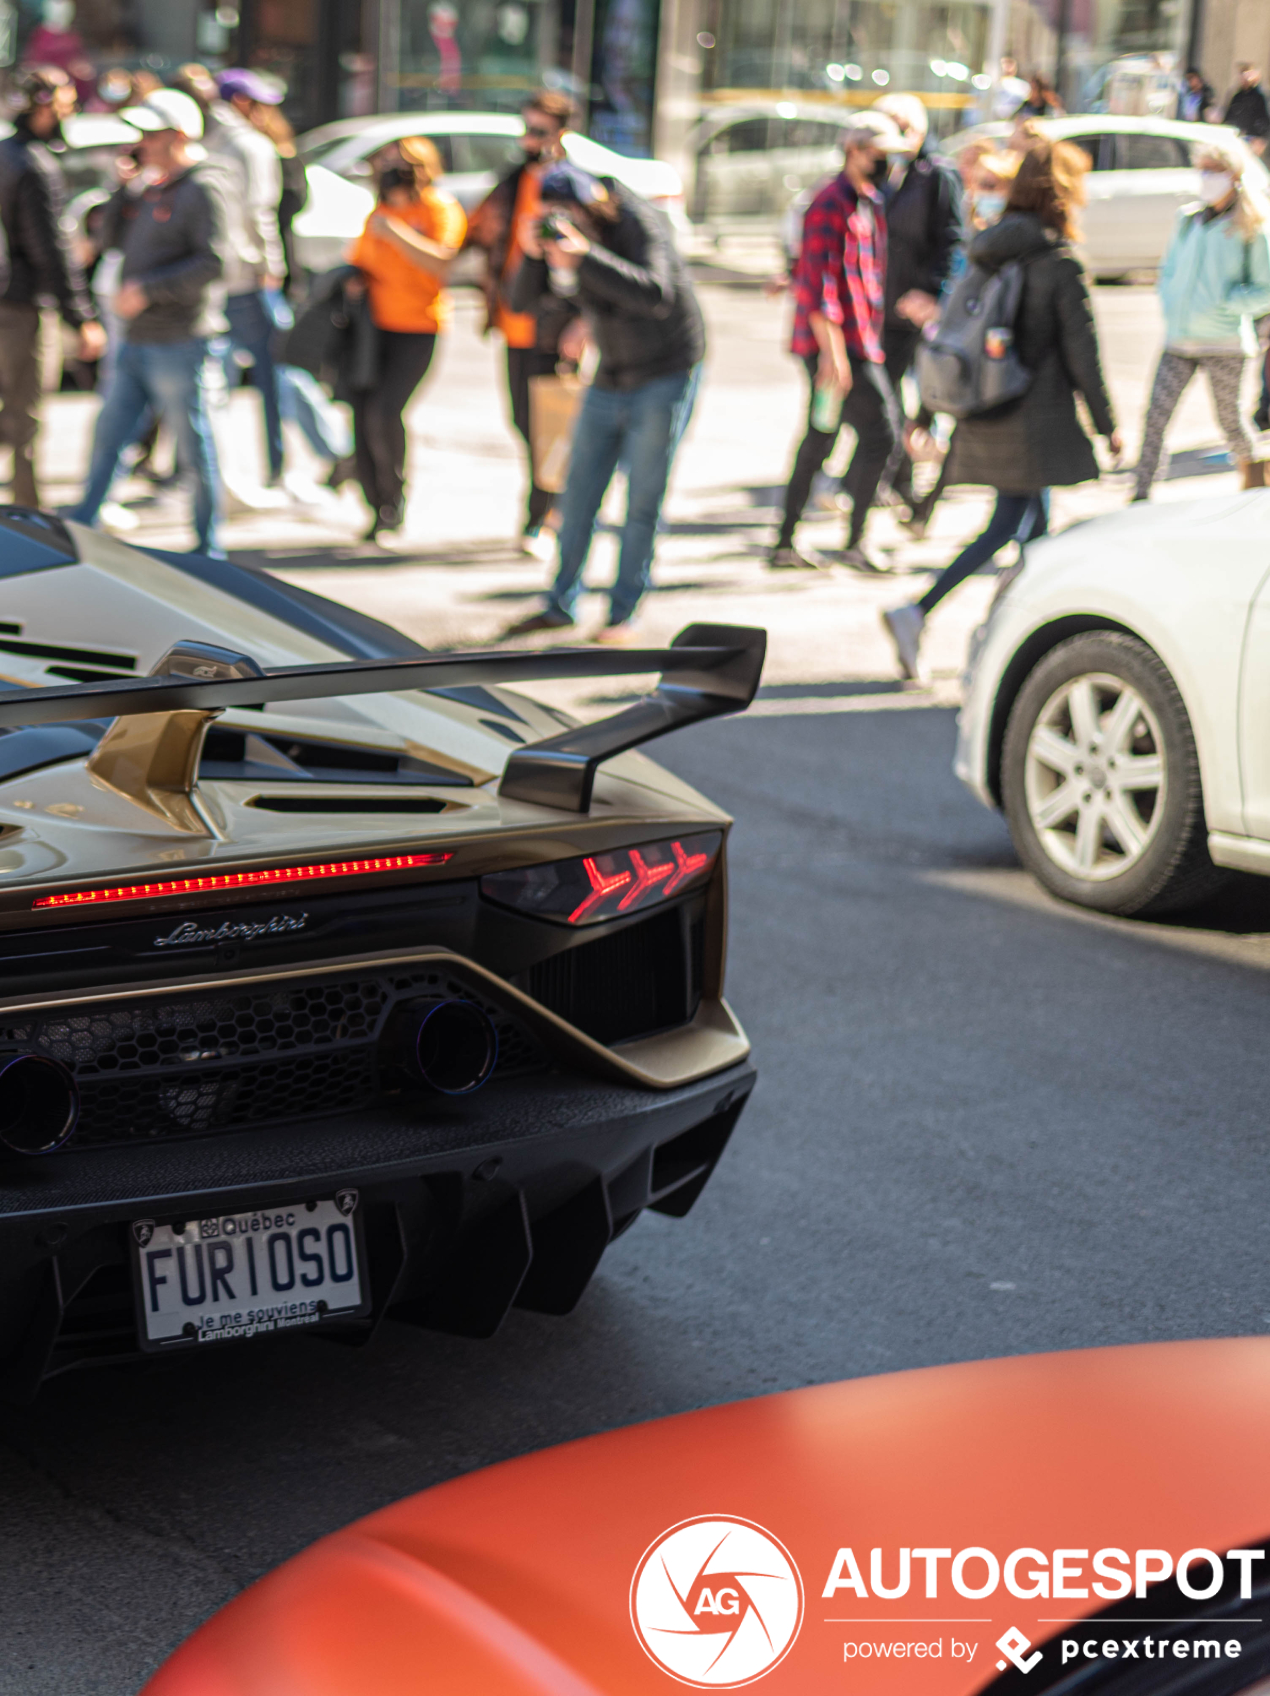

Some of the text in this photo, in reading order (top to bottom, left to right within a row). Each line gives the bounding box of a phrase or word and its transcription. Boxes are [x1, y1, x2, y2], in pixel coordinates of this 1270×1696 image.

[154, 911, 309, 946] Lamborghini
[222, 1212, 296, 1236] Québec
[146, 1222, 354, 1312] FURIOSO
[196, 1300, 317, 1330] Je me souviens
[198, 1312, 319, 1342] Lamborghini Montréal
